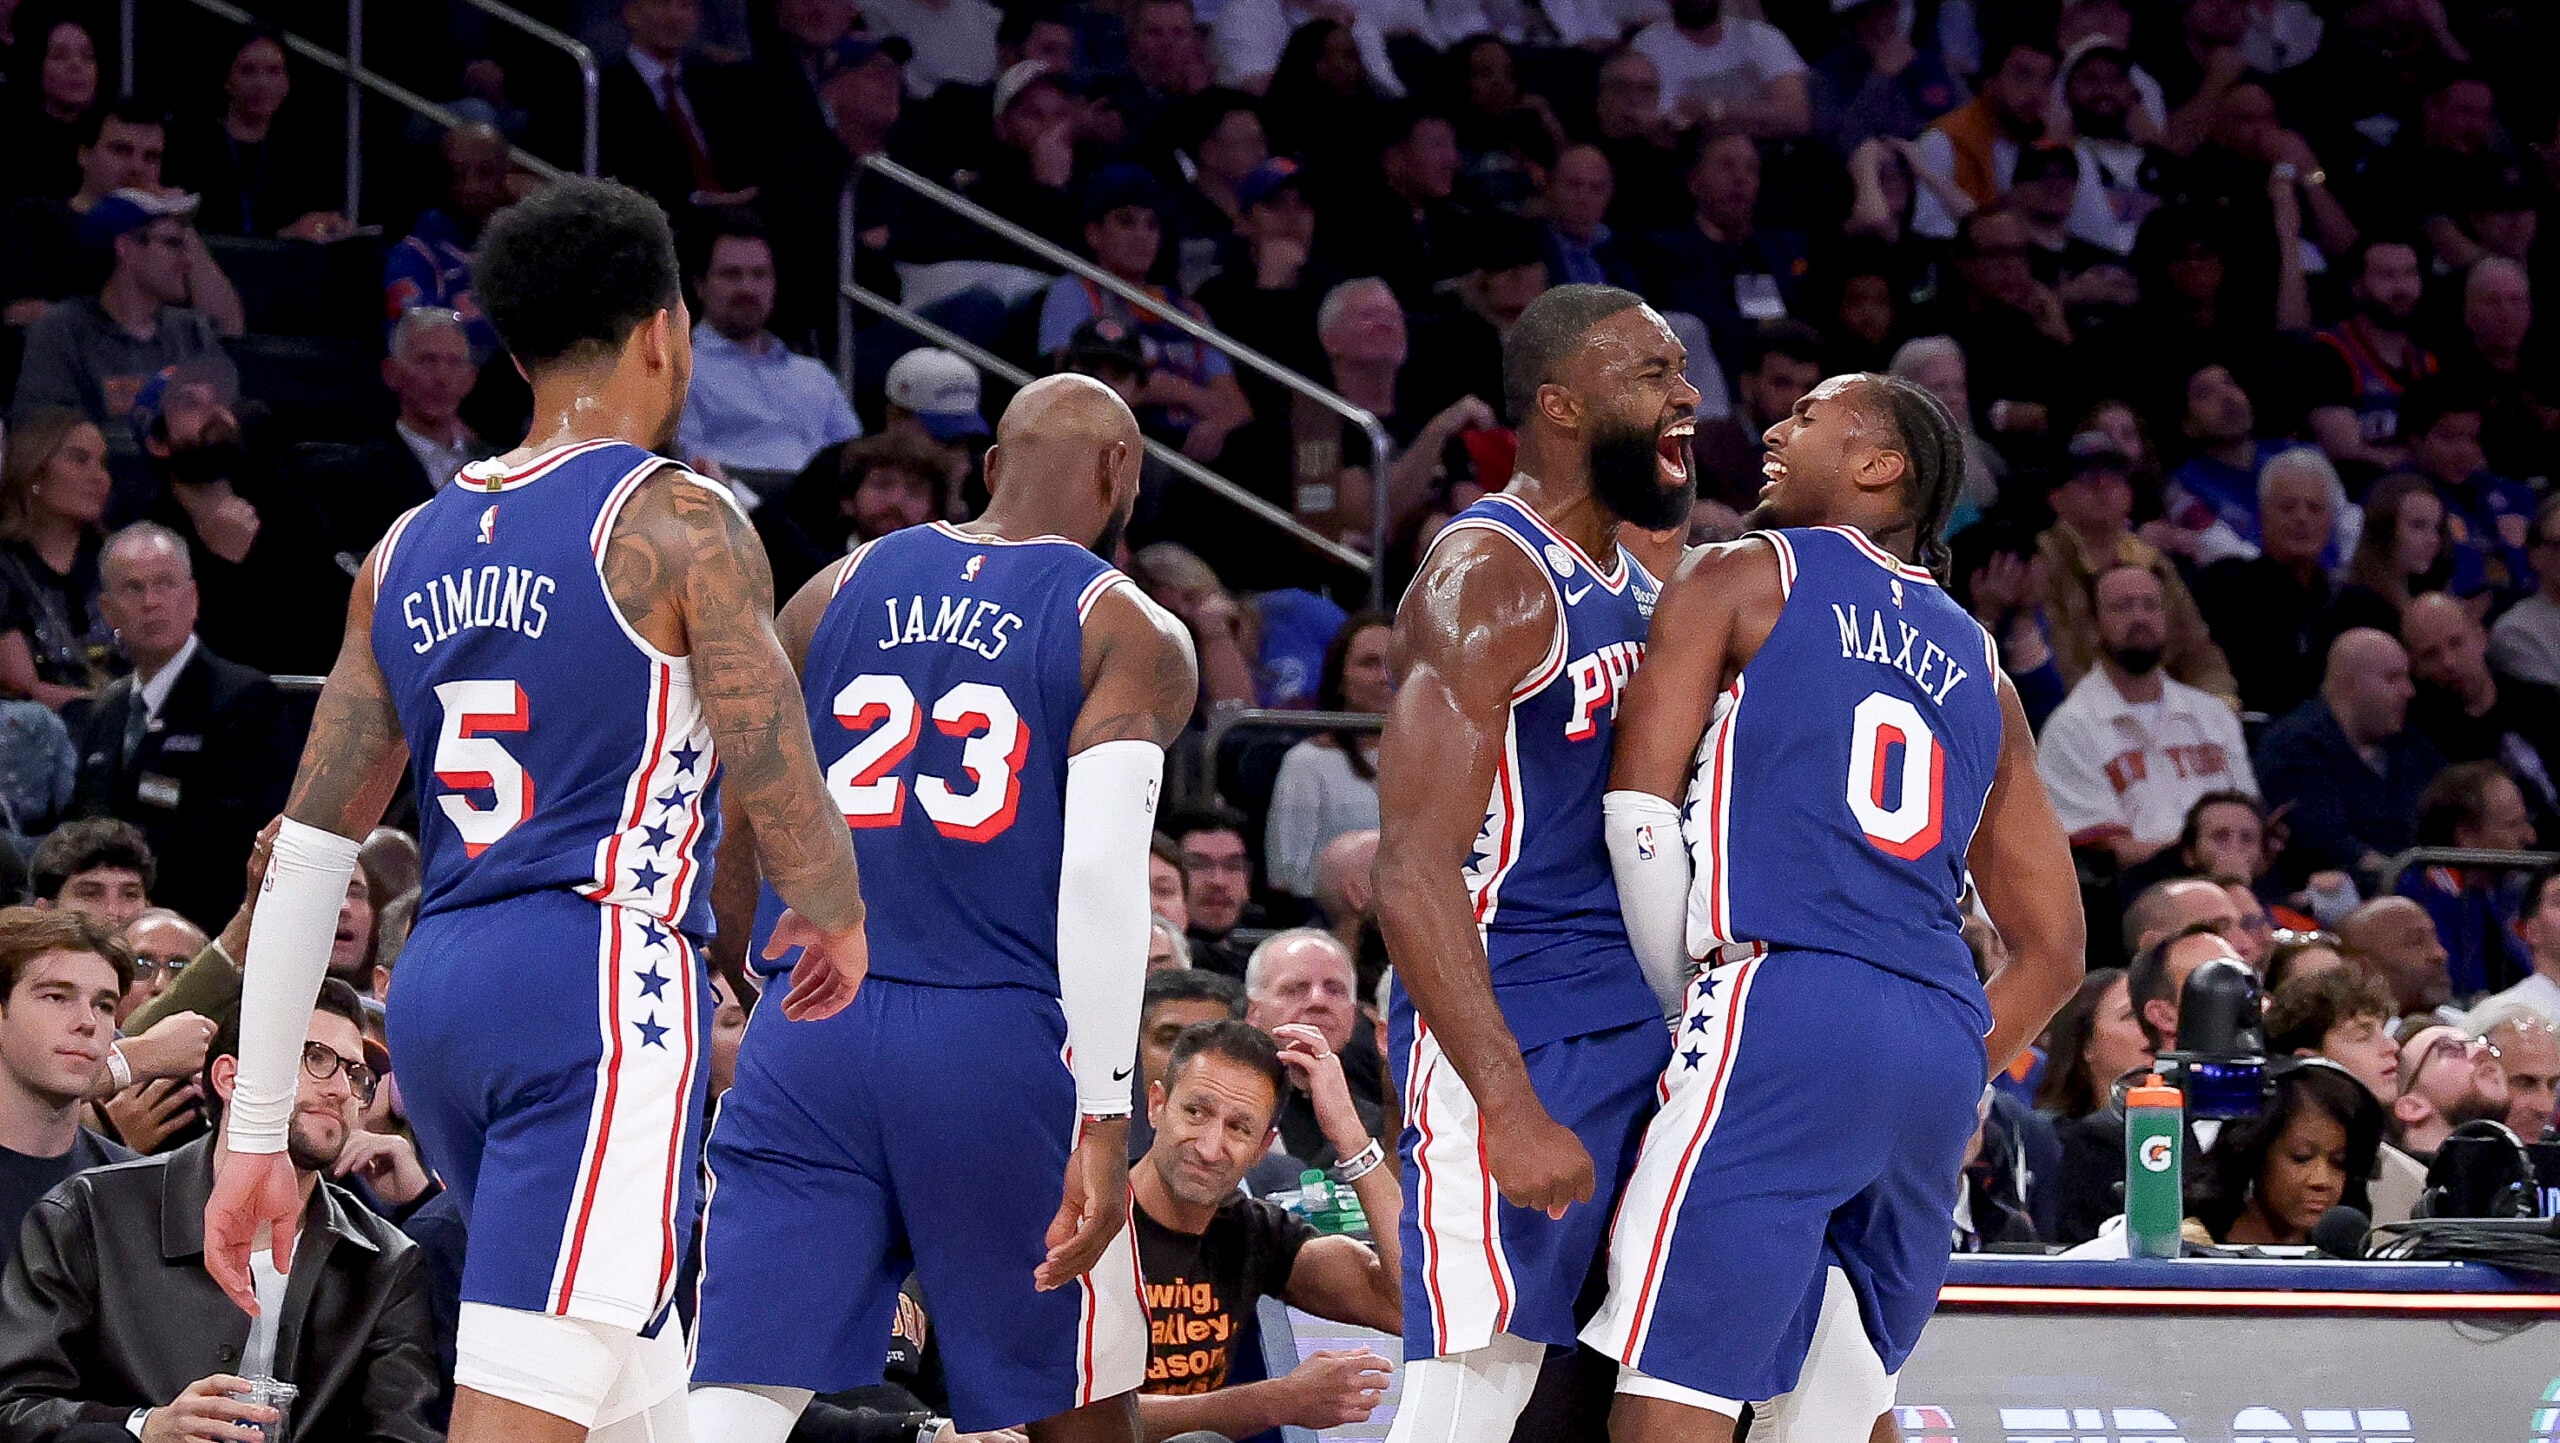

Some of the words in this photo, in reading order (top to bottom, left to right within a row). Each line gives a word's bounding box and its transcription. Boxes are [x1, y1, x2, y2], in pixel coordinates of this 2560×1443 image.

[402, 564, 556, 656] SIMONS
[877, 594, 1024, 661] JAMES
[1830, 602, 1968, 707] MAXEY
[433, 679, 535, 860] 5
[826, 674, 1031, 844] 23
[1846, 691, 1946, 862] 0
[2139, 1133, 2173, 1173] G
[1146, 1277, 1219, 1314] wing,
